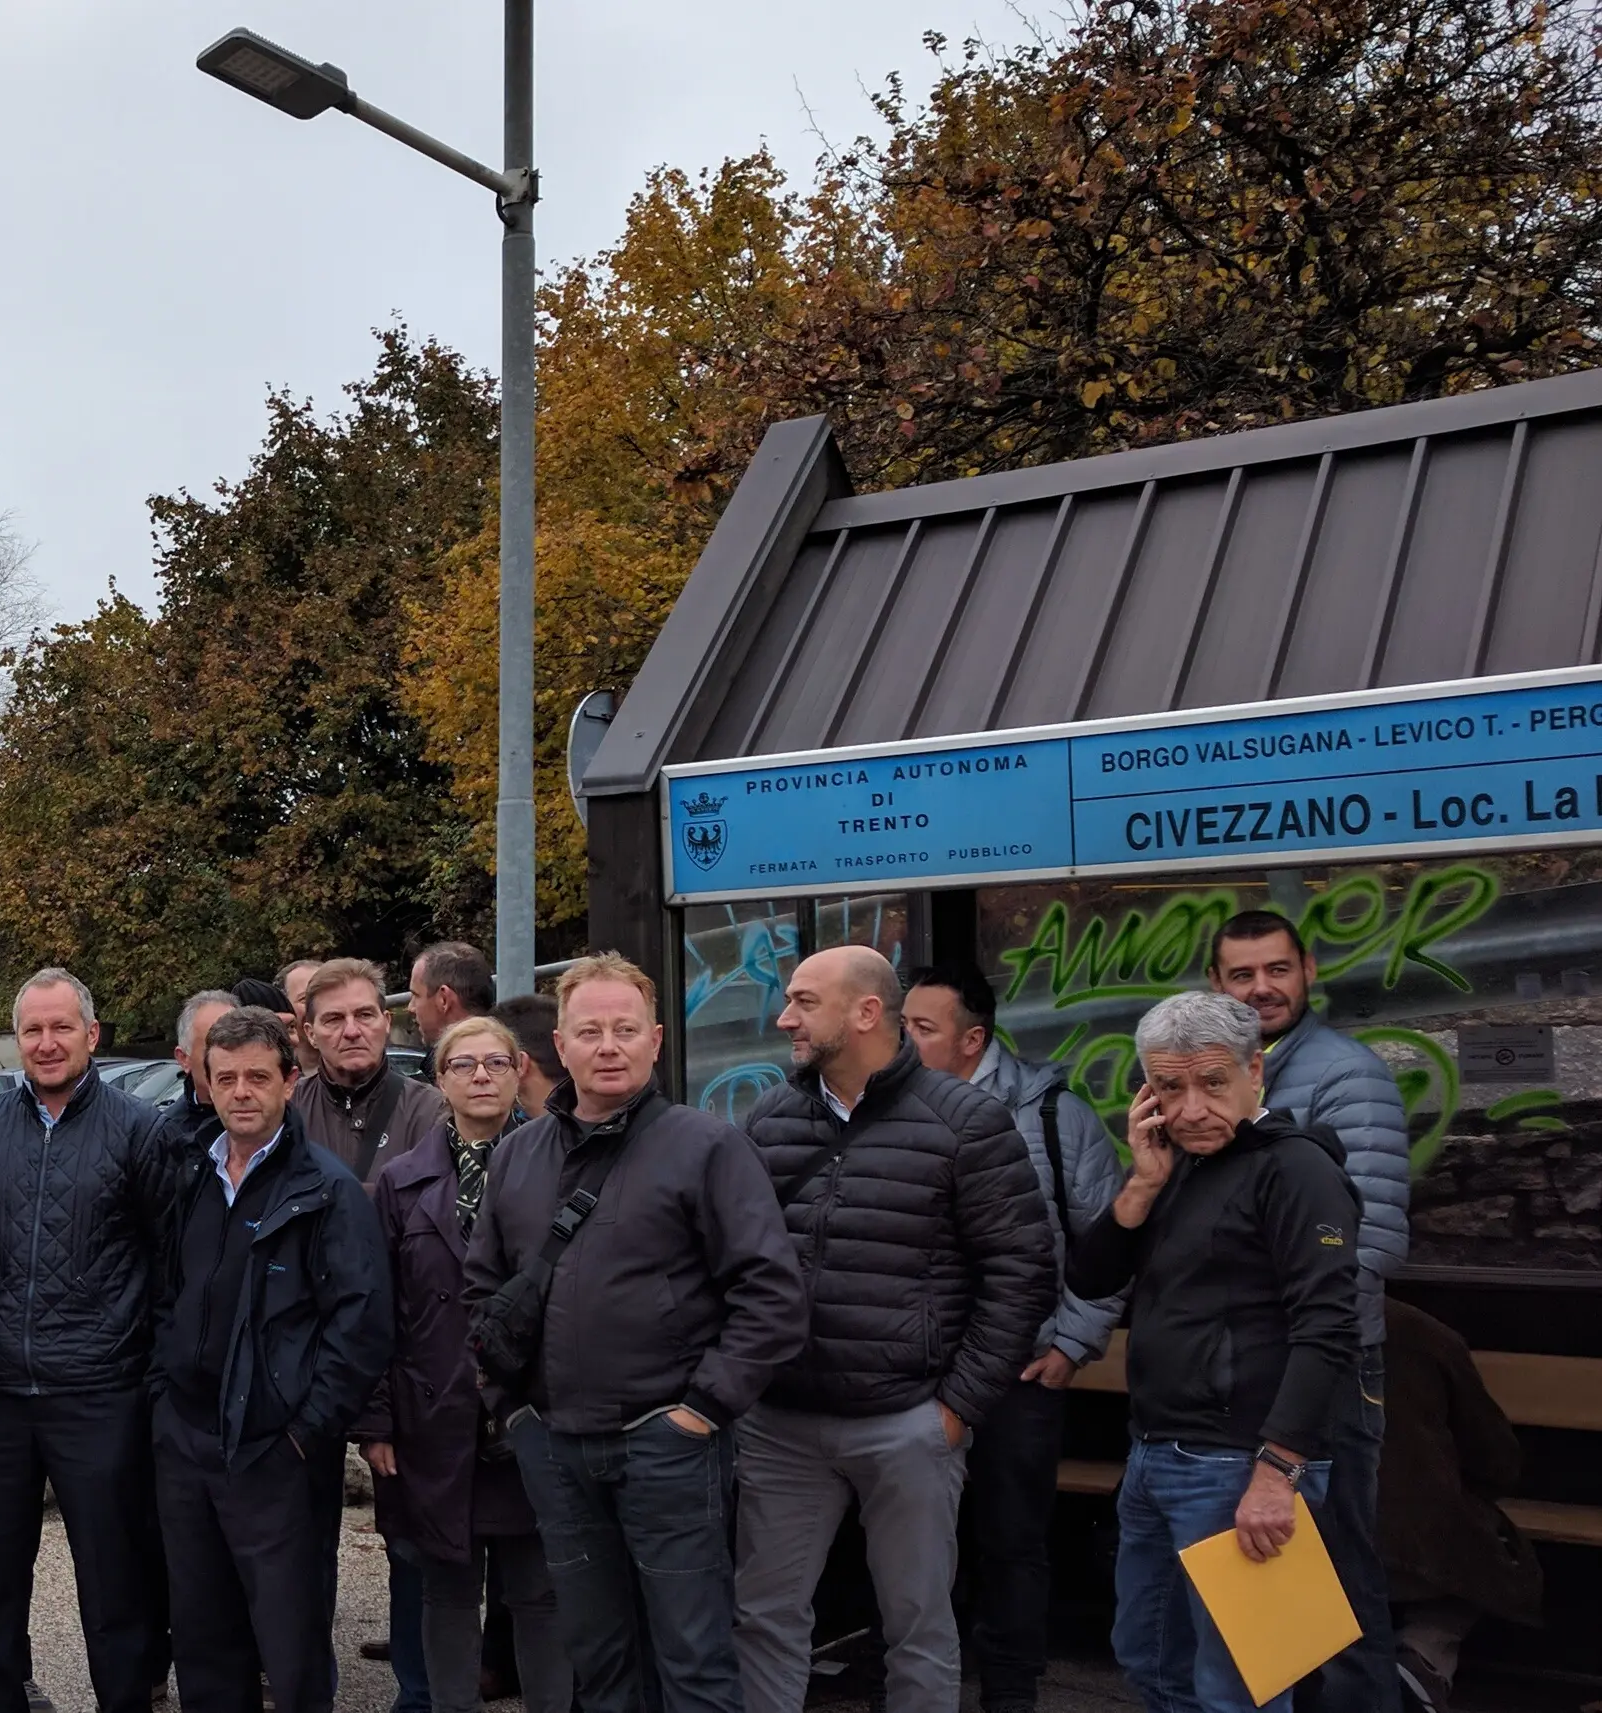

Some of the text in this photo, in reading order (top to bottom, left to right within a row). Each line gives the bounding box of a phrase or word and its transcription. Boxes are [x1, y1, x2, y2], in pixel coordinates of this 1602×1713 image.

[1101, 744, 1189, 773] BORGO
[1195, 728, 1353, 764] VALSUGANA
[1374, 716, 1475, 747] LEVICO
[1482, 713, 1504, 737] T.
[746, 754, 1028, 795] PROVINCIA AUTONOMA
[871, 791, 894, 807] DI
[1125, 793, 1372, 850] CIVEZZANO
[1412, 789, 1508, 830] Loc.
[1525, 780, 1580, 822] La
[838, 813, 929, 834] TRENTO
[749, 843, 1033, 875] FERMATA TRASPORTO PUBBLICO
